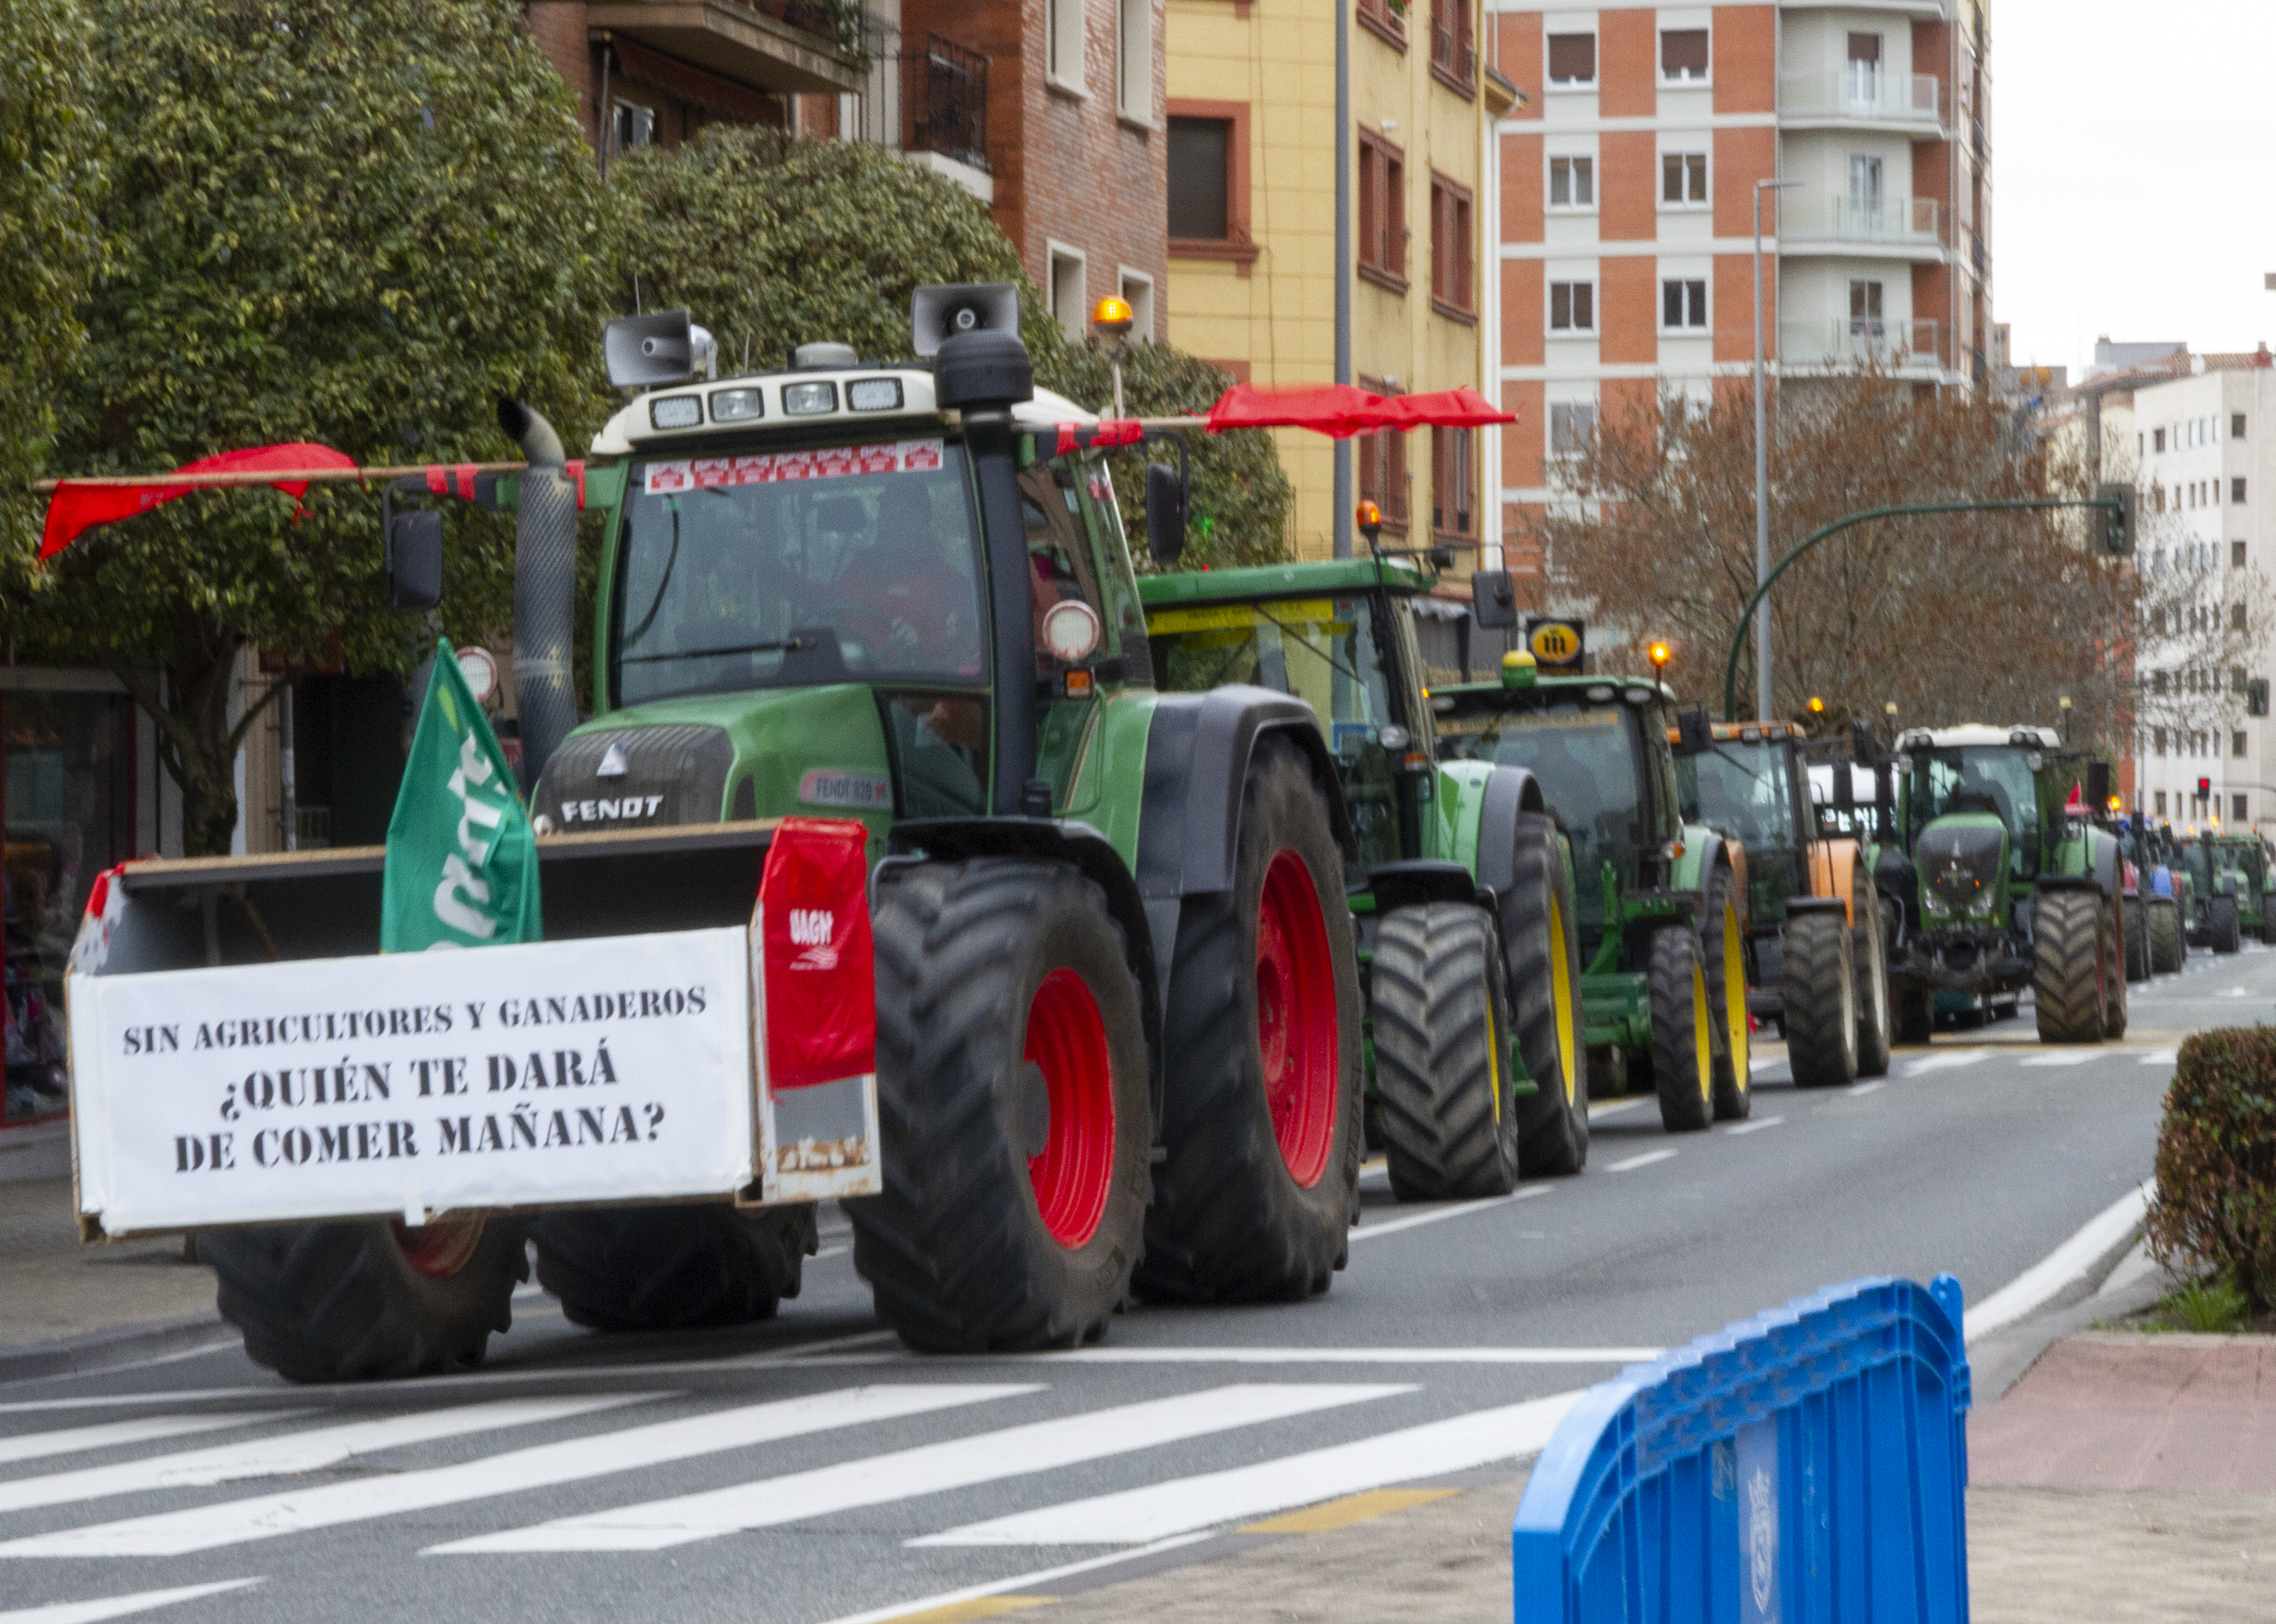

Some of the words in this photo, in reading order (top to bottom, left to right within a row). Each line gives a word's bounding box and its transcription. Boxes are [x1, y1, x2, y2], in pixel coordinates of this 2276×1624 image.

[561, 794, 664, 823] FENDT
[123, 1023, 180, 1055] SIN
[193, 1003, 453, 1051] AGRICULTORES
[466, 1001, 486, 1030] Y
[498, 985, 707, 1028] GANADEROS
[220, 1054, 392, 1122] ¿QUIÉN
[410, 1056, 469, 1098] TE
[485, 1036, 619, 1092] DARÁ
[173, 1130, 236, 1174] DE
[252, 1120, 421, 1169] COMER
[436, 1101, 665, 1156] MAÑANA?
